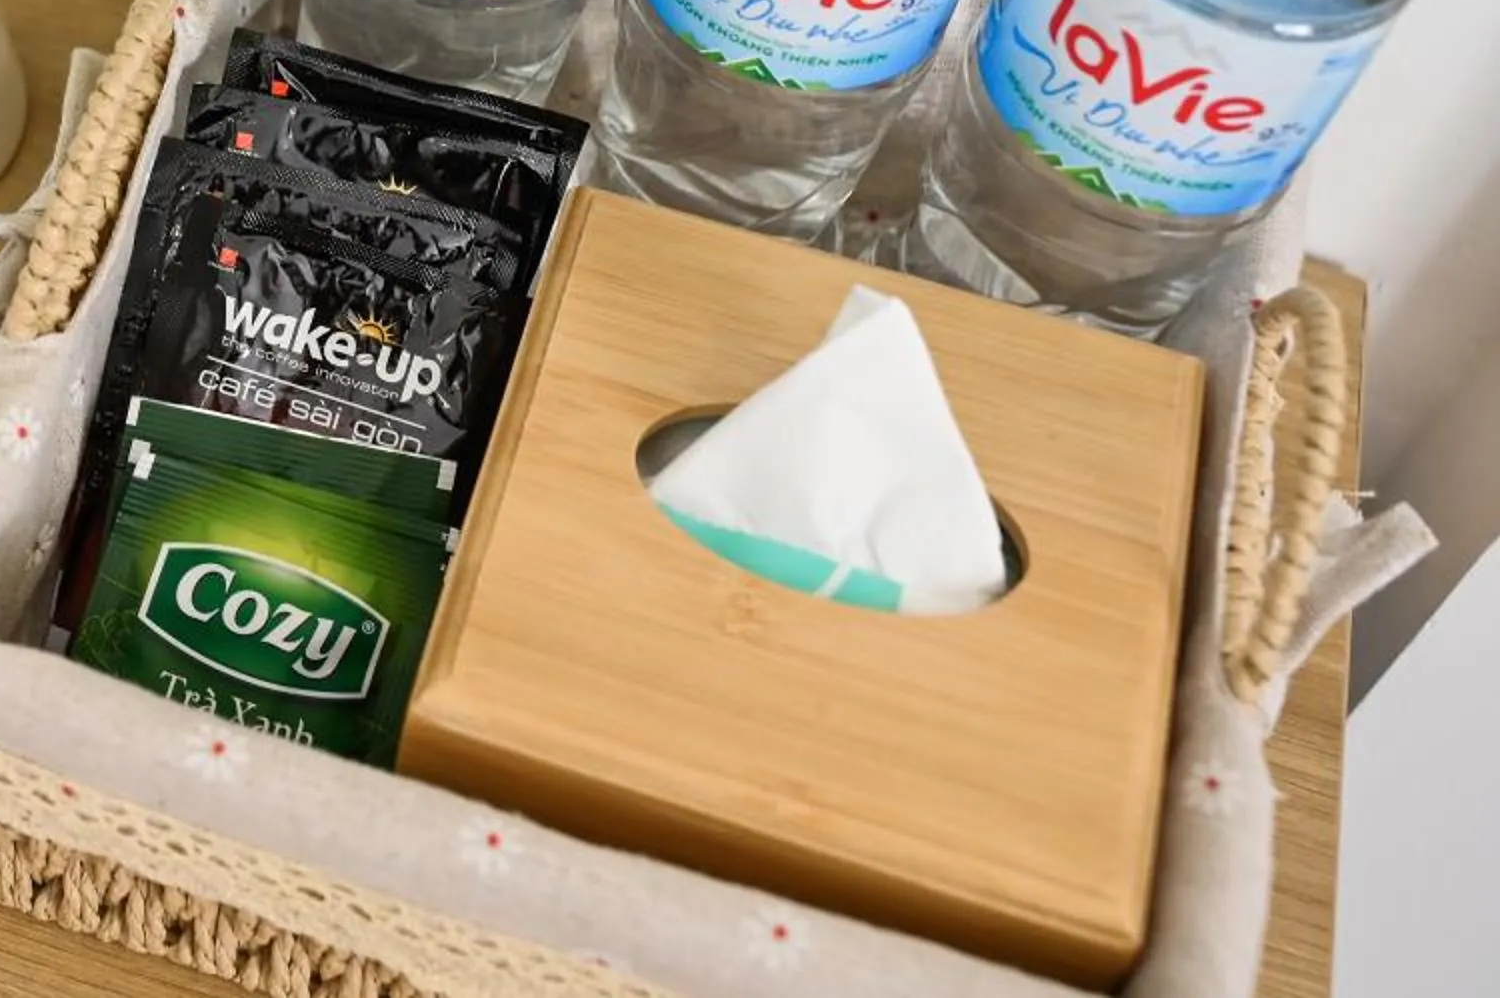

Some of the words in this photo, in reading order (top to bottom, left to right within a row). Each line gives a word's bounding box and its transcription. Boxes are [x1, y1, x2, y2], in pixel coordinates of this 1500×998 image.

[225, 296, 441, 402] wake-up
[198, 368, 276, 409] café
[288, 398, 342, 430] sài
[352, 420, 422, 455] gòn
[175, 563, 357, 679] Cozy
[159, 669, 217, 715] Trà
